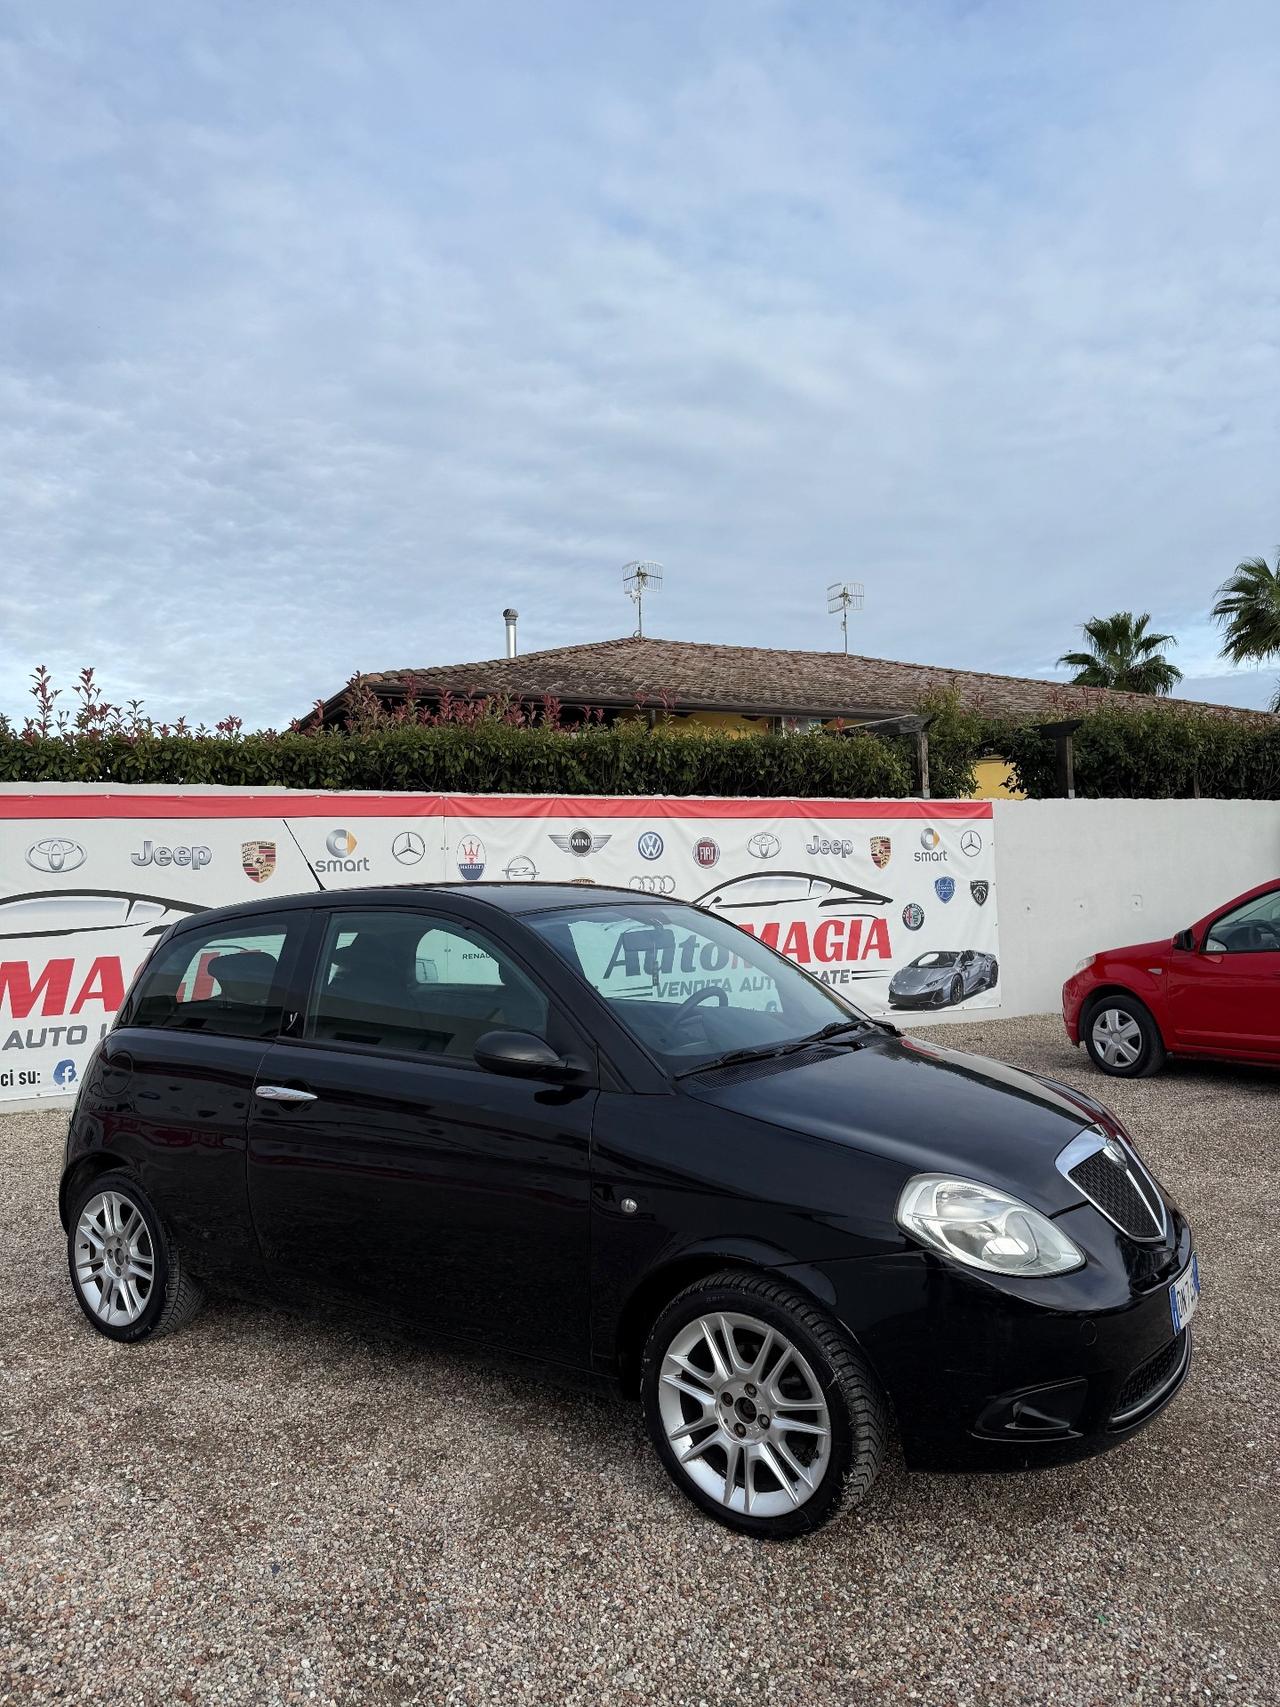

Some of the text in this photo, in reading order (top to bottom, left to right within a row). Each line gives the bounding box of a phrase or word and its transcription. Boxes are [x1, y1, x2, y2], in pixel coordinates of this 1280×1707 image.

[571, 838, 591, 847] MINI
[806, 835, 853, 859] Jeep
[131, 840, 212, 870] Jeep
[699, 846, 715, 860] FIAT
[914, 849, 948, 862] smart
[315, 856, 370, 873] smart
[2, 1023, 88, 1051] AUTO
[19, 1070, 41, 1086] su:
